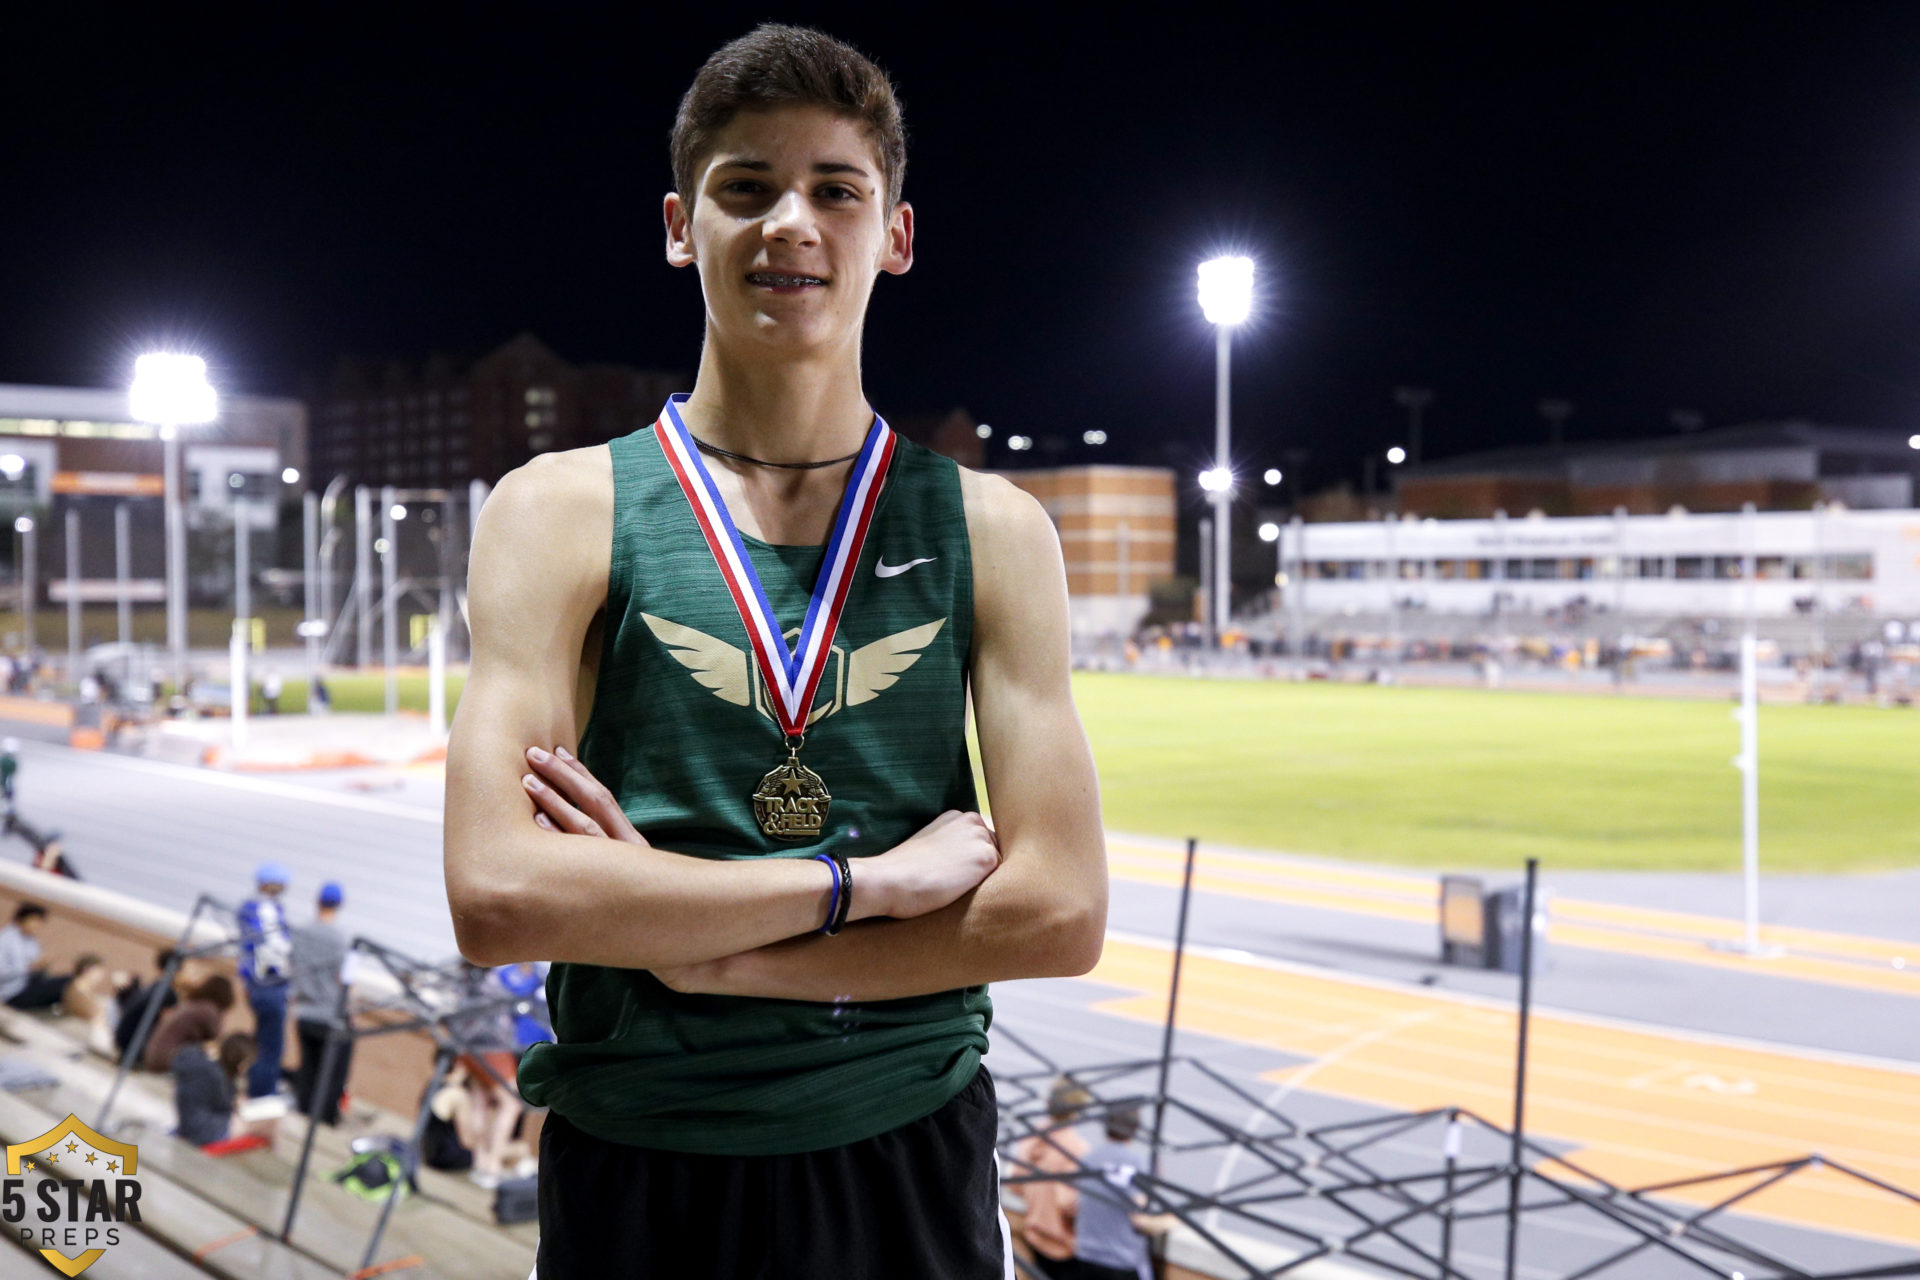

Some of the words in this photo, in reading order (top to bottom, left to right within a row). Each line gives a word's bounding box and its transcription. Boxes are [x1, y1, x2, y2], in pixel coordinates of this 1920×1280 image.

[765, 797, 819, 813] TRACK
[763, 812, 783, 835] &
[781, 813, 822, 829] FIELD
